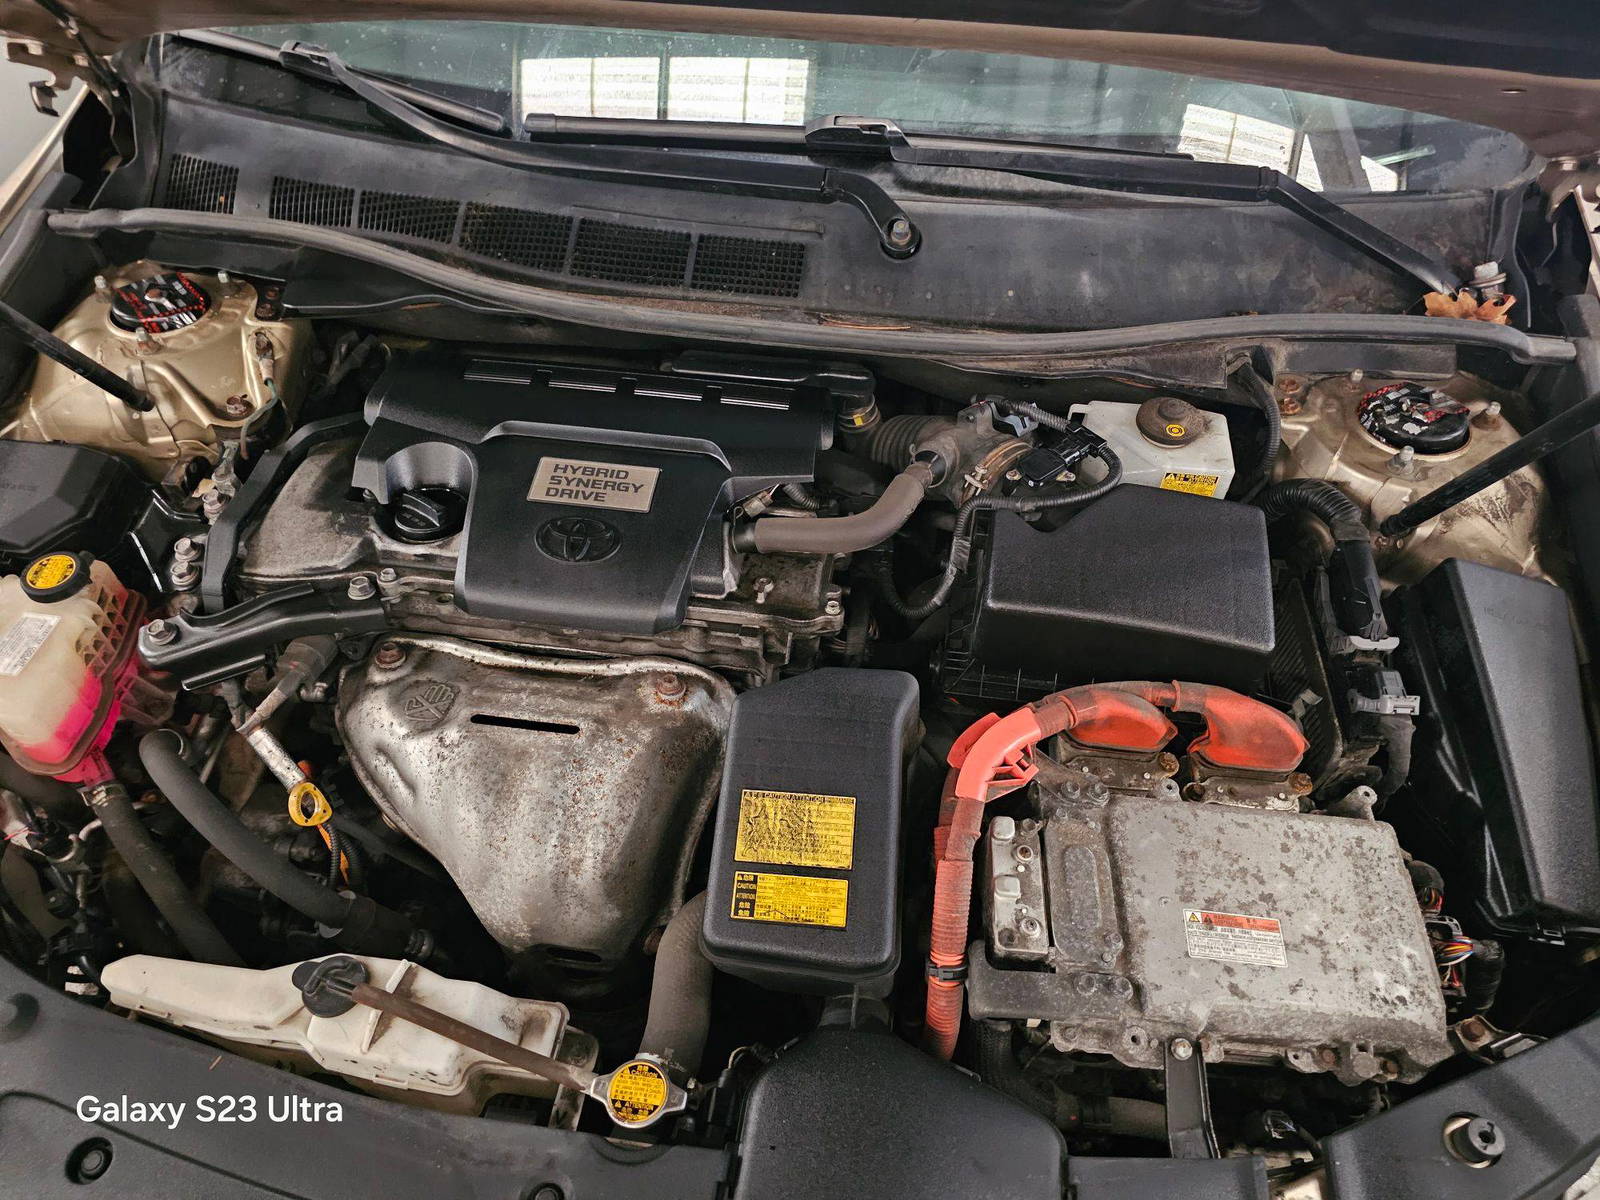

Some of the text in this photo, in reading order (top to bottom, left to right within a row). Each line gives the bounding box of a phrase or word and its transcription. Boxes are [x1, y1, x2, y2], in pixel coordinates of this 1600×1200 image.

[553, 464, 629, 479] HYBRID
[548, 475, 644, 493] SYNERGY
[545, 487, 607, 502] DRIVE
[631, 1070, 658, 1079] CAUTION
[625, 1101, 654, 1111] ATTENTION
